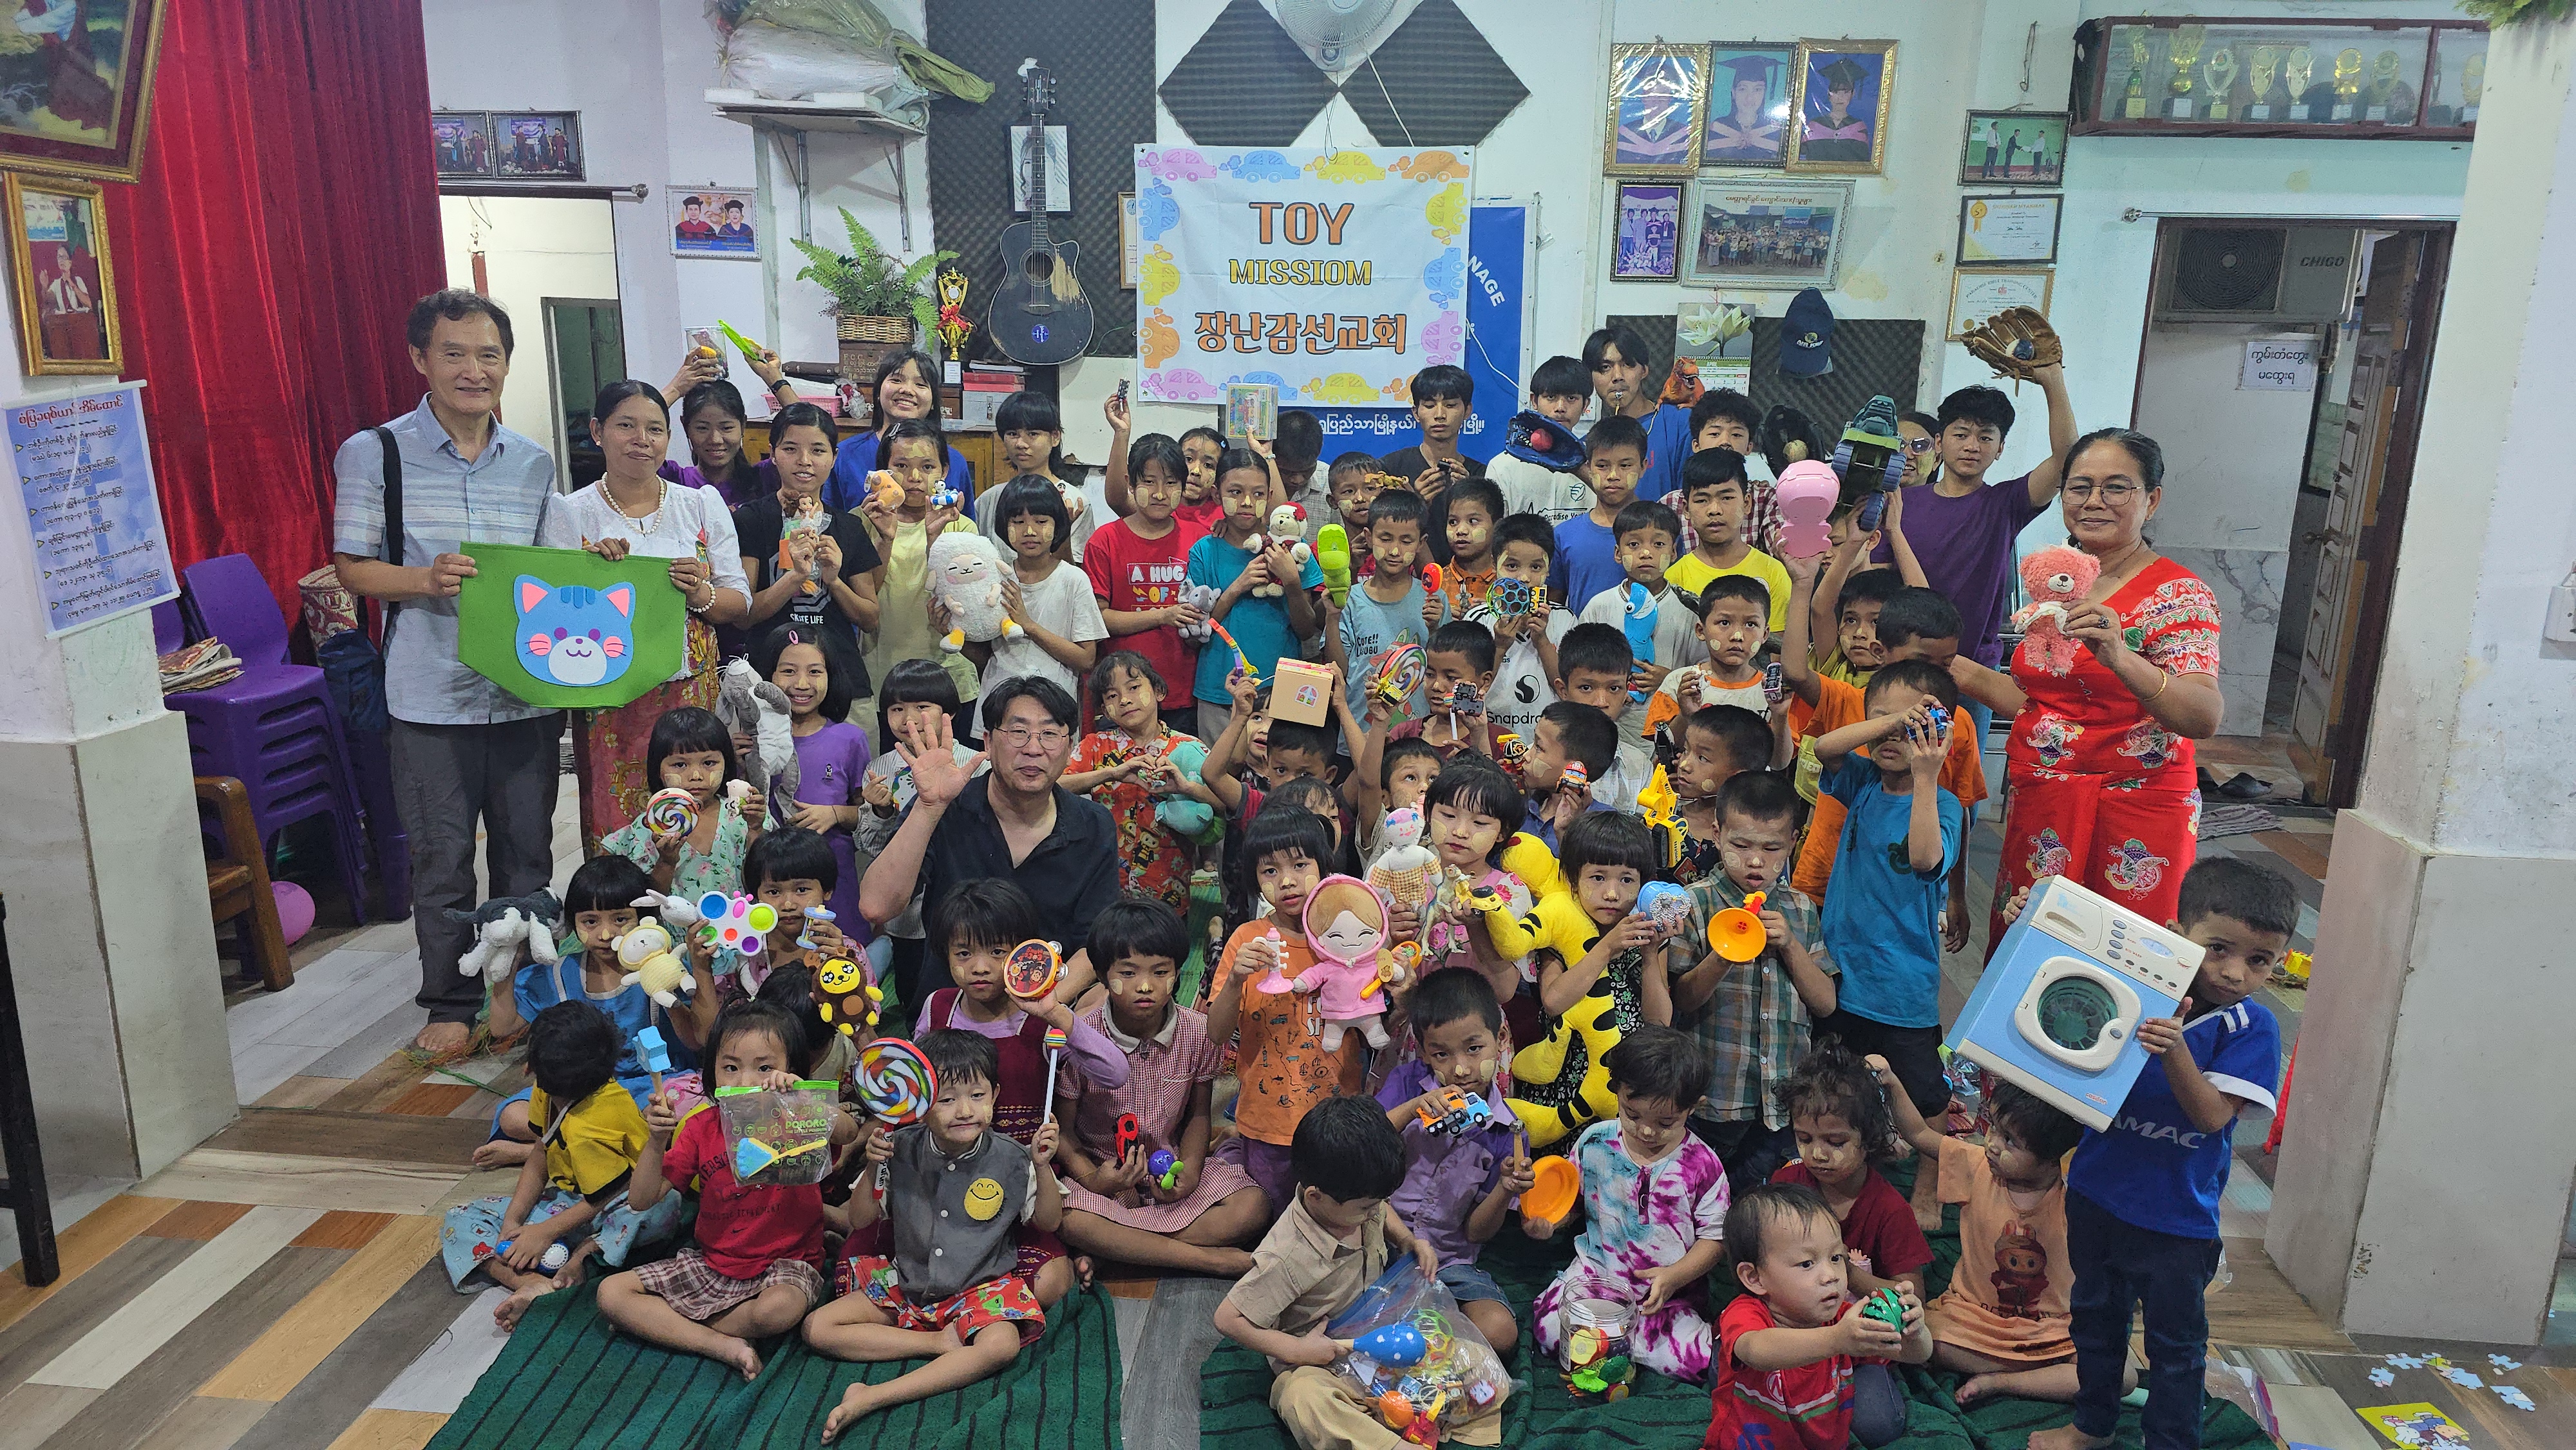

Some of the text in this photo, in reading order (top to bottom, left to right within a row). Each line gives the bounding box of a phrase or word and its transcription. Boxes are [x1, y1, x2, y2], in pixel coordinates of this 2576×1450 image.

[1249, 202, 1354, 245] TOY
[2300, 256, 2345, 267] CHIGO
[1229, 259, 1372, 286] MISSIOM
[1195, 311, 1408, 355] 장난감선교회
[2259, 371, 2295, 384] မထွေးရ
[1132, 565, 1185, 583] A HUG
[1149, 586, 1170, 603] OF
[810, 615, 824, 624] LIFE
